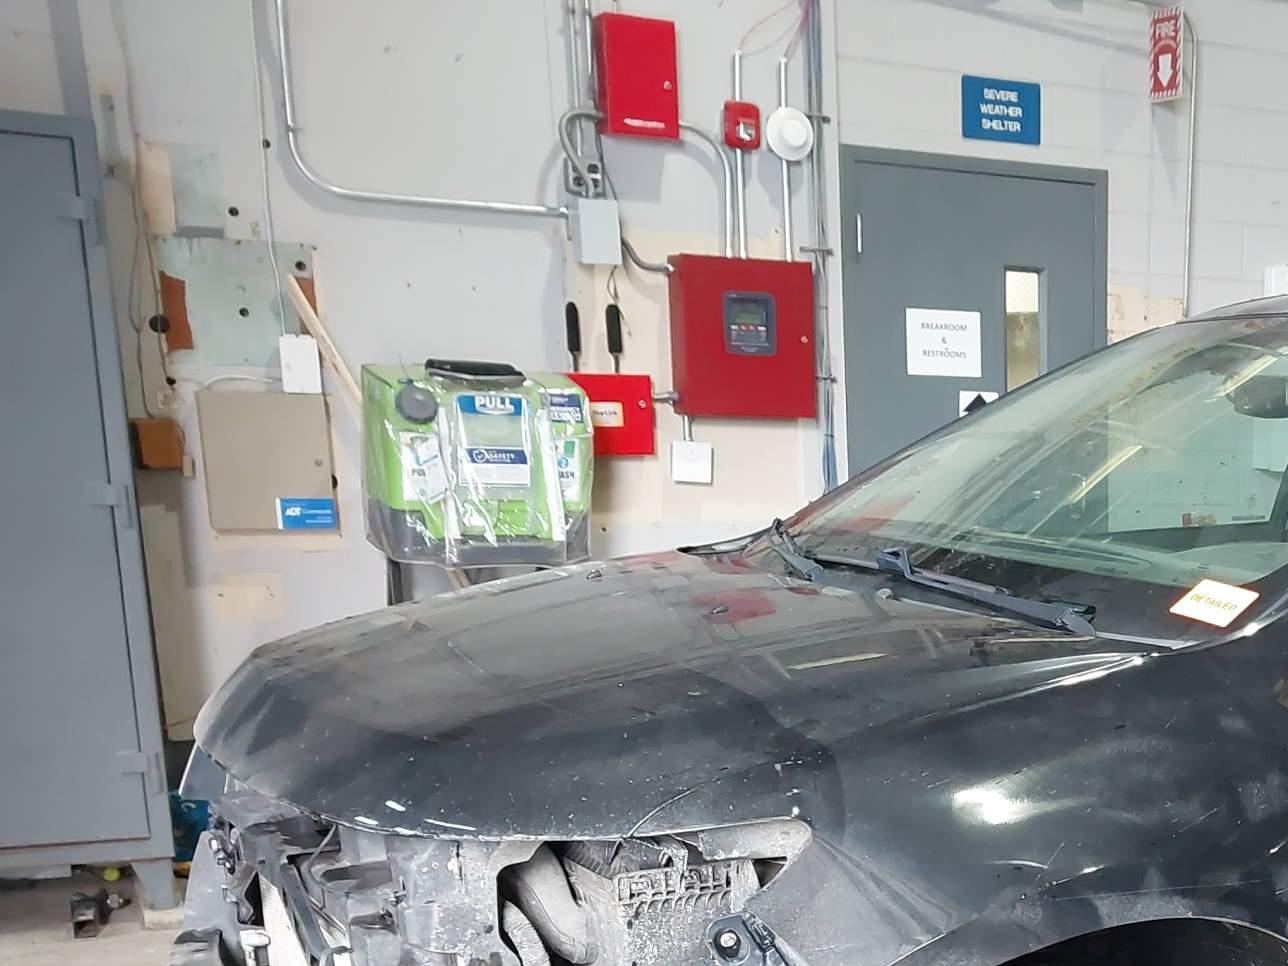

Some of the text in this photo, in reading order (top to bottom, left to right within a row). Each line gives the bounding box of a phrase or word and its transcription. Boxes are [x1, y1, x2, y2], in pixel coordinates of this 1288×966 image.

[1155, 20, 1177, 39] FIRE
[983, 88, 1019, 102] SEVERE
[979, 102, 1023, 117] WEATHER
[981, 118, 1021, 132] SHELTER
[921, 322, 968, 332] BREAKROOM
[922, 349, 967, 359] RESTROOMS
[475, 396, 513, 410] PULL
